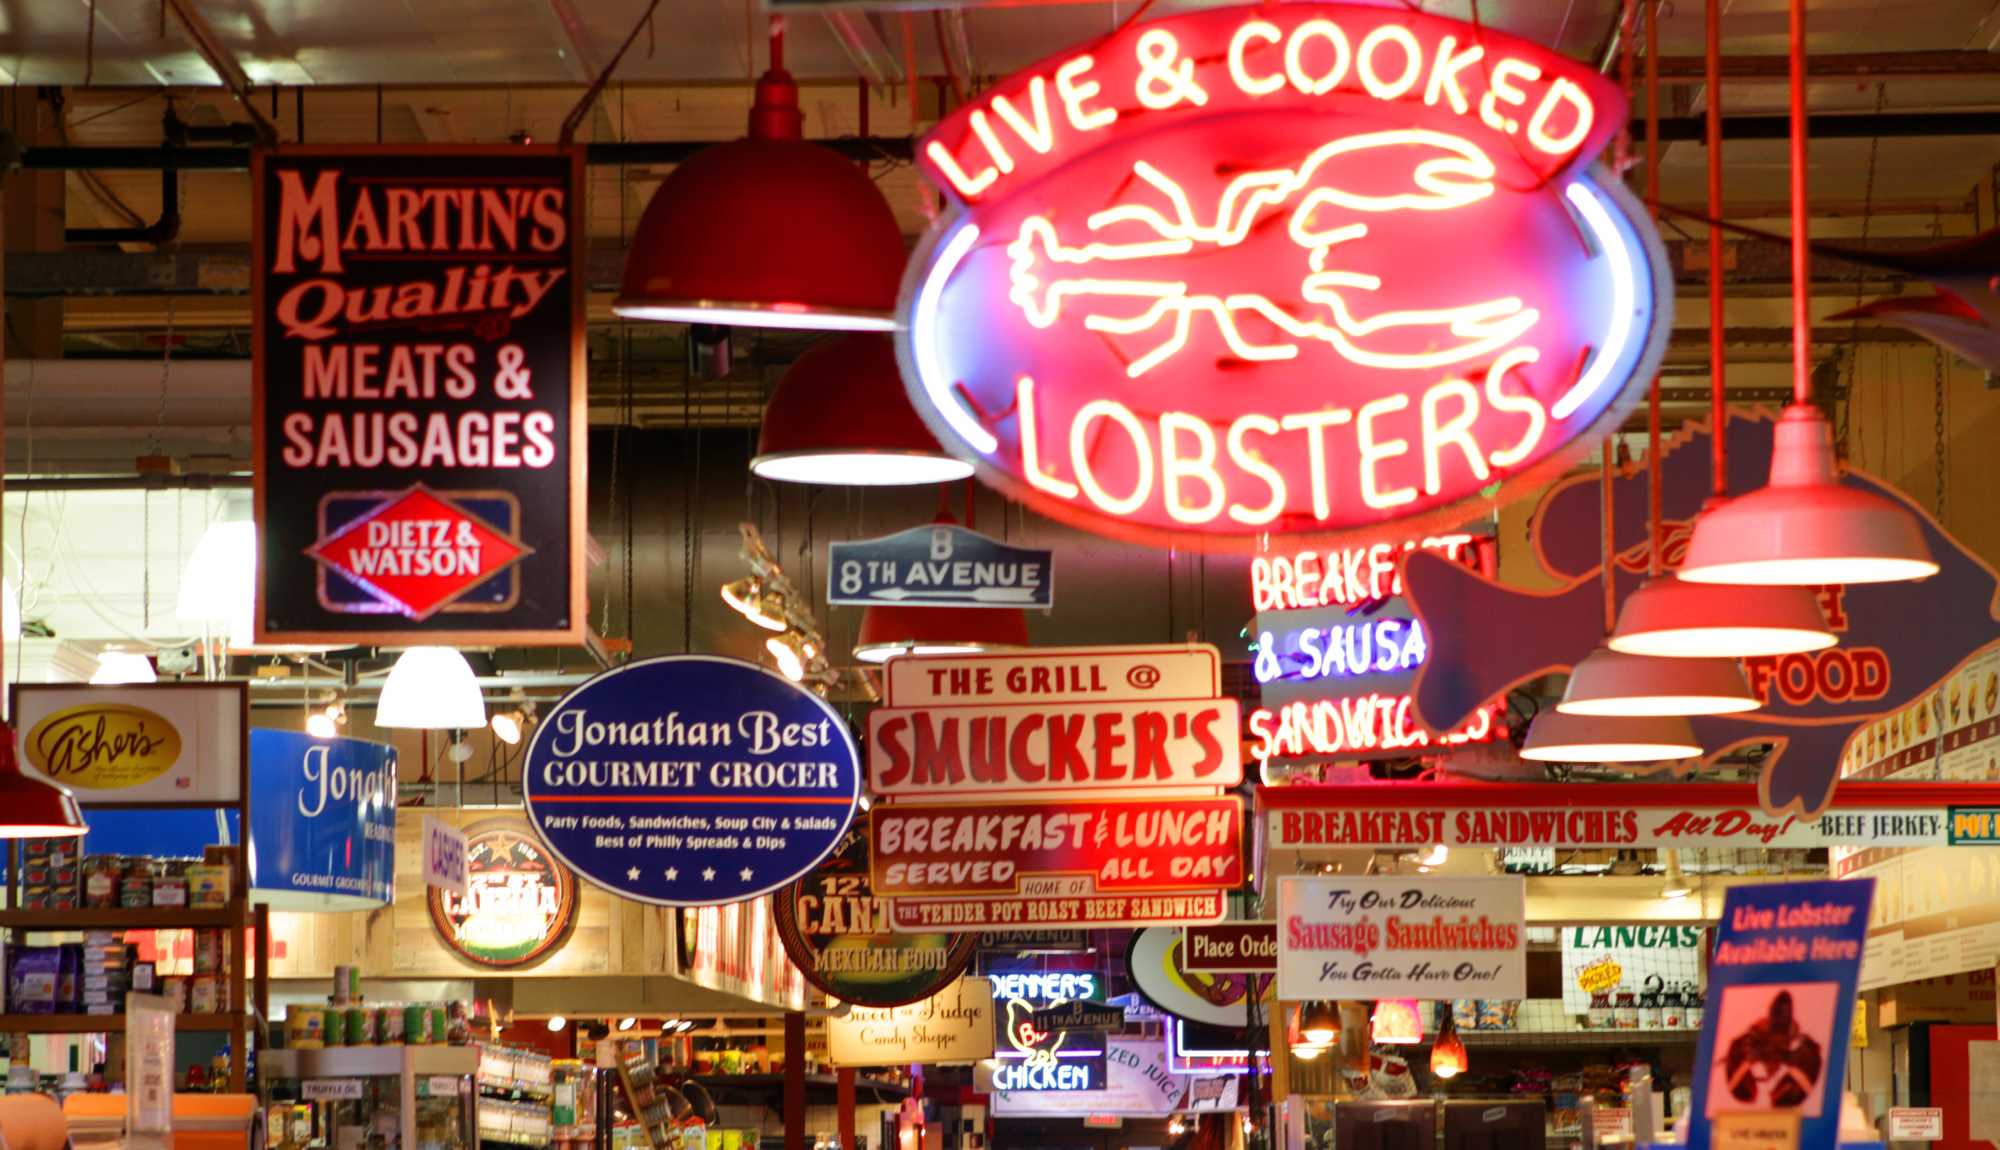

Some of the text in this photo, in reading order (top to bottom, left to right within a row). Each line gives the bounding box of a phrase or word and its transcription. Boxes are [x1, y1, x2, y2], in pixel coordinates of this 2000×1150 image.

[927, 18, 1596, 197] LIVE & COOKED
[273, 169, 567, 274] MARTIN'S
[275, 265, 567, 340] Quality
[303, 343, 533, 400] MEATS &
[282, 411, 556, 468] SAUSAGES
[1017, 345, 1547, 526] LOBSTERS
[367, 519, 482, 548] DIETZ &
[930, 528, 953, 560] B
[349, 548, 481, 577] WATSON
[840, 559, 1041, 594] 8TH AVENUE
[1254, 619, 1427, 683] & SAUSA
[927, 664, 1161, 696] THE GRILL @
[1743, 650, 1890, 704] FOOD
[552, 709, 831, 757] Jonathan Best
[875, 707, 1224, 788] SMUCKER'S
[298, 745, 396, 818] Jonath
[543, 760, 839, 788] GOURMET GROCER
[544, 815, 837, 832] Party Foods, Sandwiches, Soup City & Salads
[878, 810, 1094, 855] BREAKFAST
[1114, 808, 1234, 849] LUNCH
[1282, 810, 1798, 845] BREAKFAST SANDWICHES All Day!
[1821, 815, 1870, 837] BEEF
[1872, 815, 1939, 839] JERKEY
[595, 835, 786, 851] Best of Philly Spreads & Dips
[885, 853, 1235, 886] SERVED ALL DAY
[1025, 878, 1087, 895] HOME OF
[1328, 889, 1476, 914] Try Our Delicious
[919, 901, 986, 925] TENDER
[991, 900, 1022, 922] POT
[1027, 898, 1080, 921] ROAST
[1085, 897, 1127, 920] BEEF
[1130, 895, 1217, 919] SANDWICH
[1732, 901, 1856, 932] Live Lobster
[1193, 933, 1277, 958] Place Orde
[1287, 914, 1519, 957] Sausage Sandwiches
[1573, 927, 1697, 949] LANCAS
[1714, 936, 1807, 965] Available
[1809, 937, 1860, 961] Here
[812, 948, 948, 974] MEXICAN FOOD
[1319, 962, 1347, 983] You
[1406, 962, 1451, 982] Have
[1064, 1011, 1121, 1026] AVENUE
[860, 1025, 958, 1051] Candy Shoppe
[992, 1065, 1089, 1090] CHICKEN
[1142, 1063, 1181, 1103] JUICE
